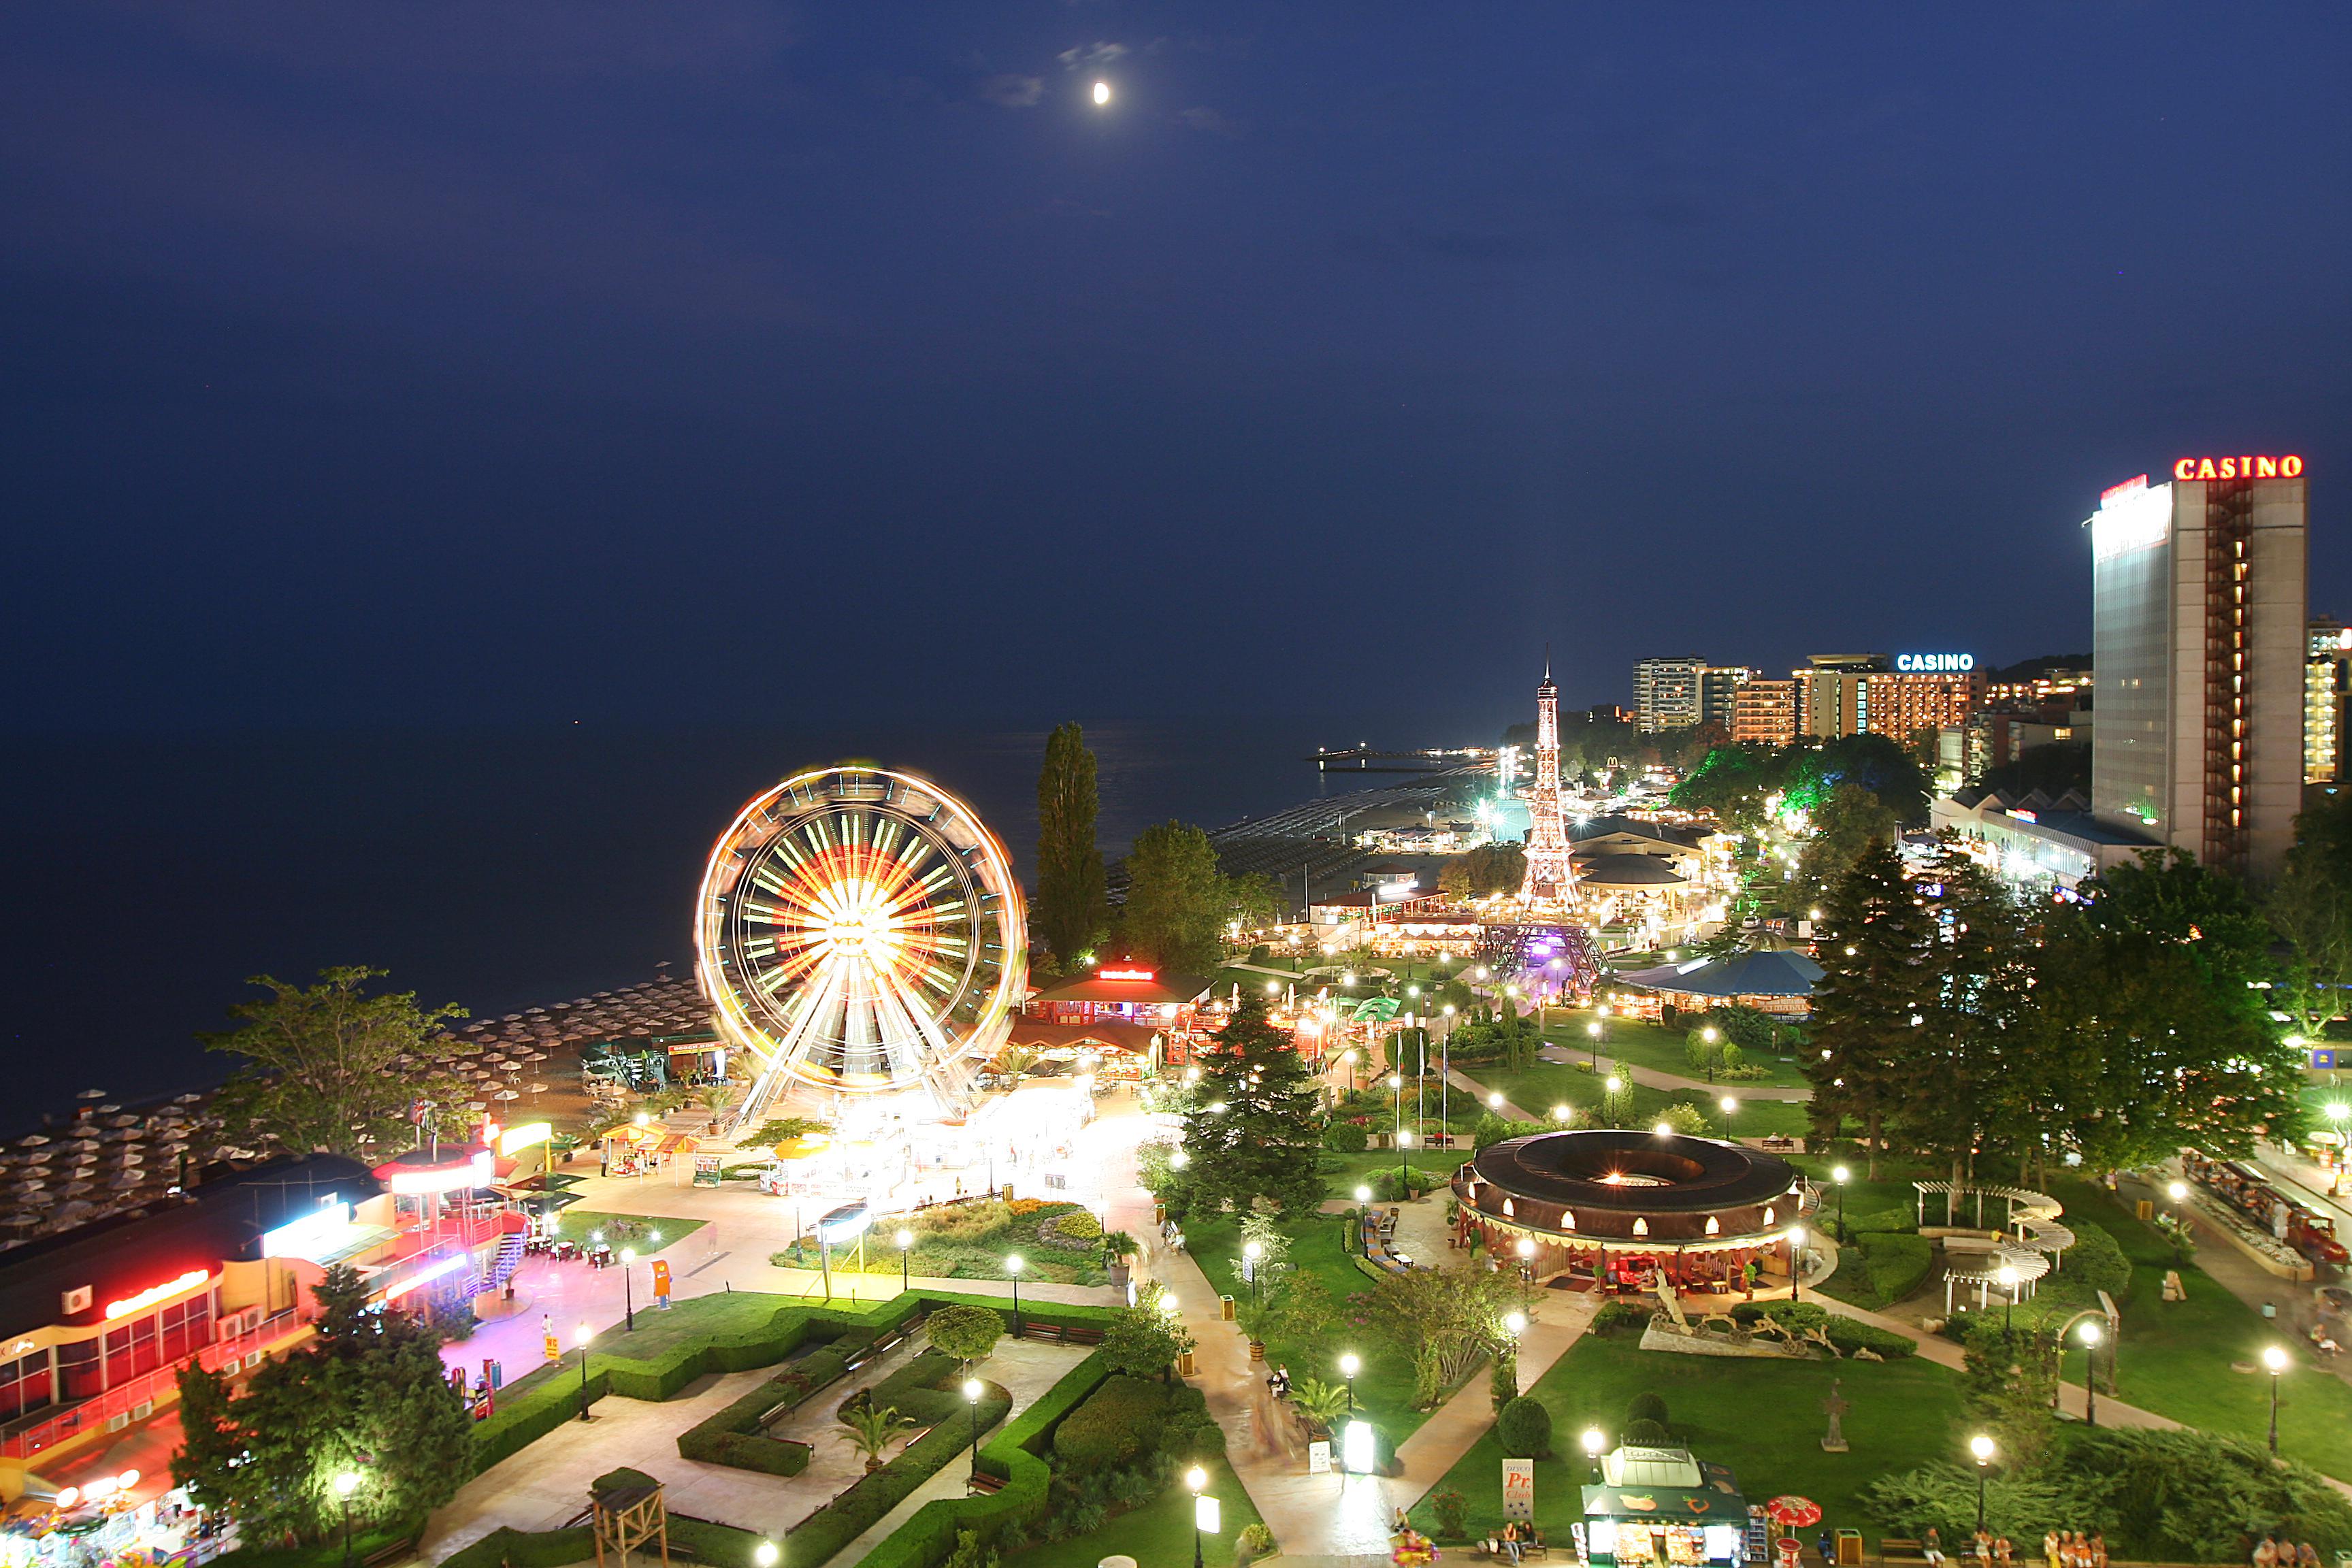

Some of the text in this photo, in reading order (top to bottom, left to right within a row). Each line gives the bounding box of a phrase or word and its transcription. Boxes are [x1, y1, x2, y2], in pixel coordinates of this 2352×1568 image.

[2174, 455, 2304, 480] CASINO
[1897, 653, 1974, 671] CASINO
[546, 1339, 557, 1348] WC
[1506, 1490, 1531, 1499] Club
